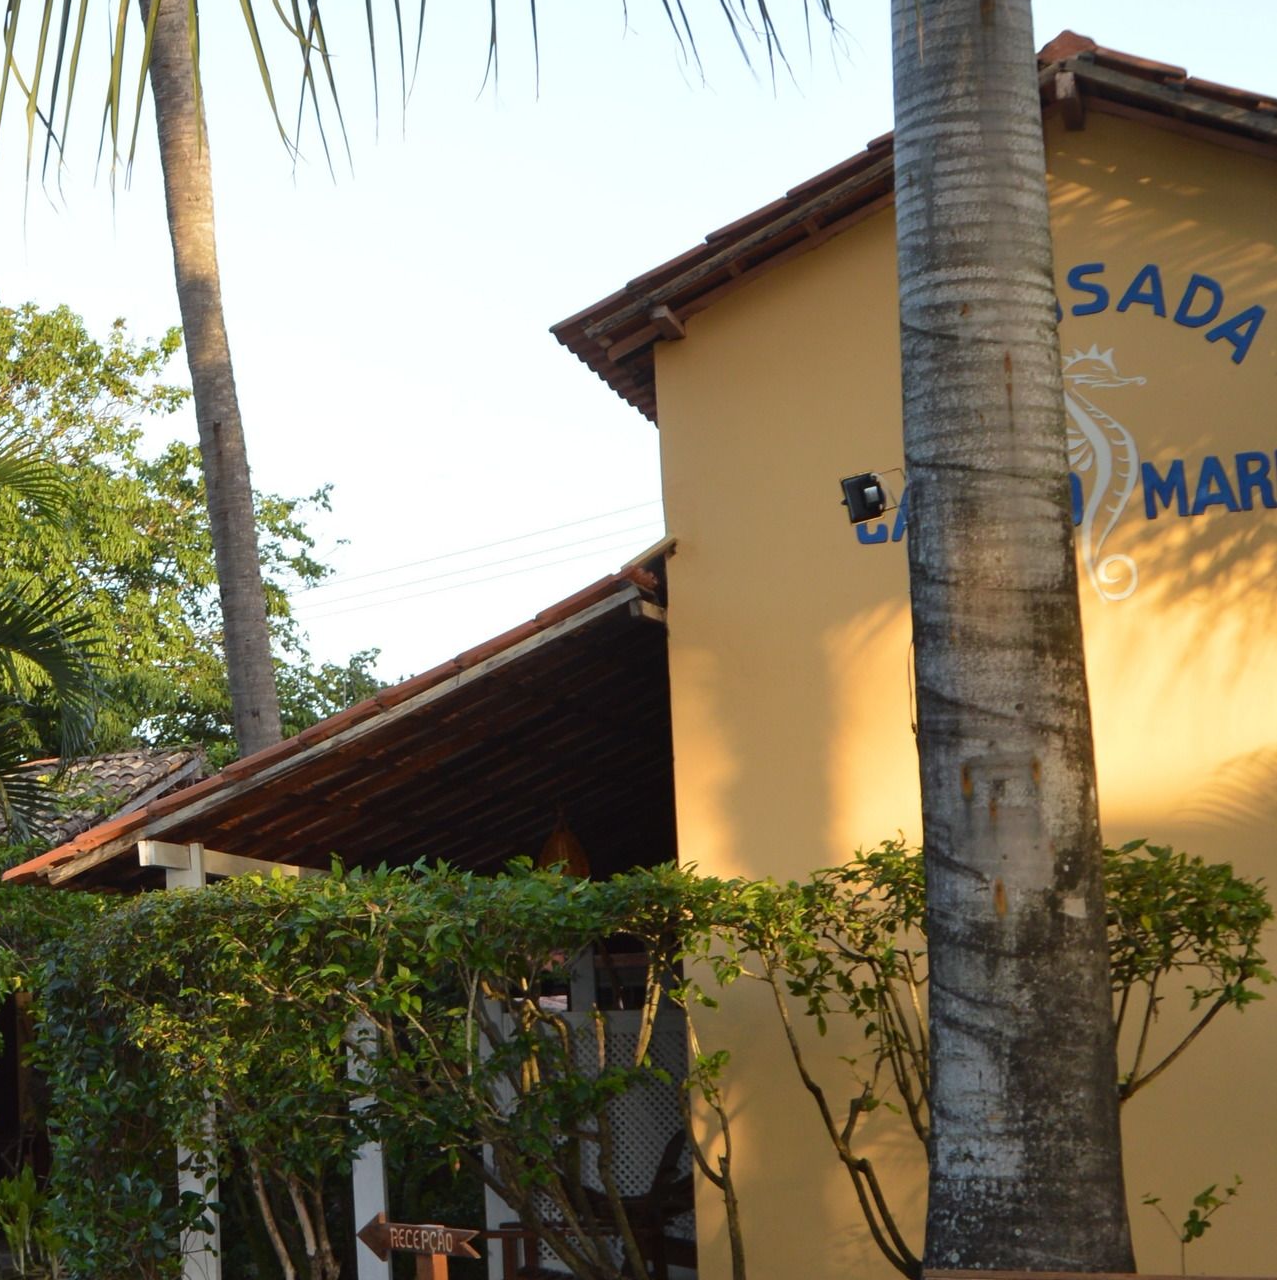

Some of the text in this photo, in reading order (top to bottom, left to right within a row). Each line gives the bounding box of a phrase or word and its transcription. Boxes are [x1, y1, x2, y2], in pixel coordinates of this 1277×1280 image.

[1056, 262, 1267, 365] SADA
[1141, 449, 1277, 519] MAR
[389, 1227, 454, 1253] RECEPÇÃO
